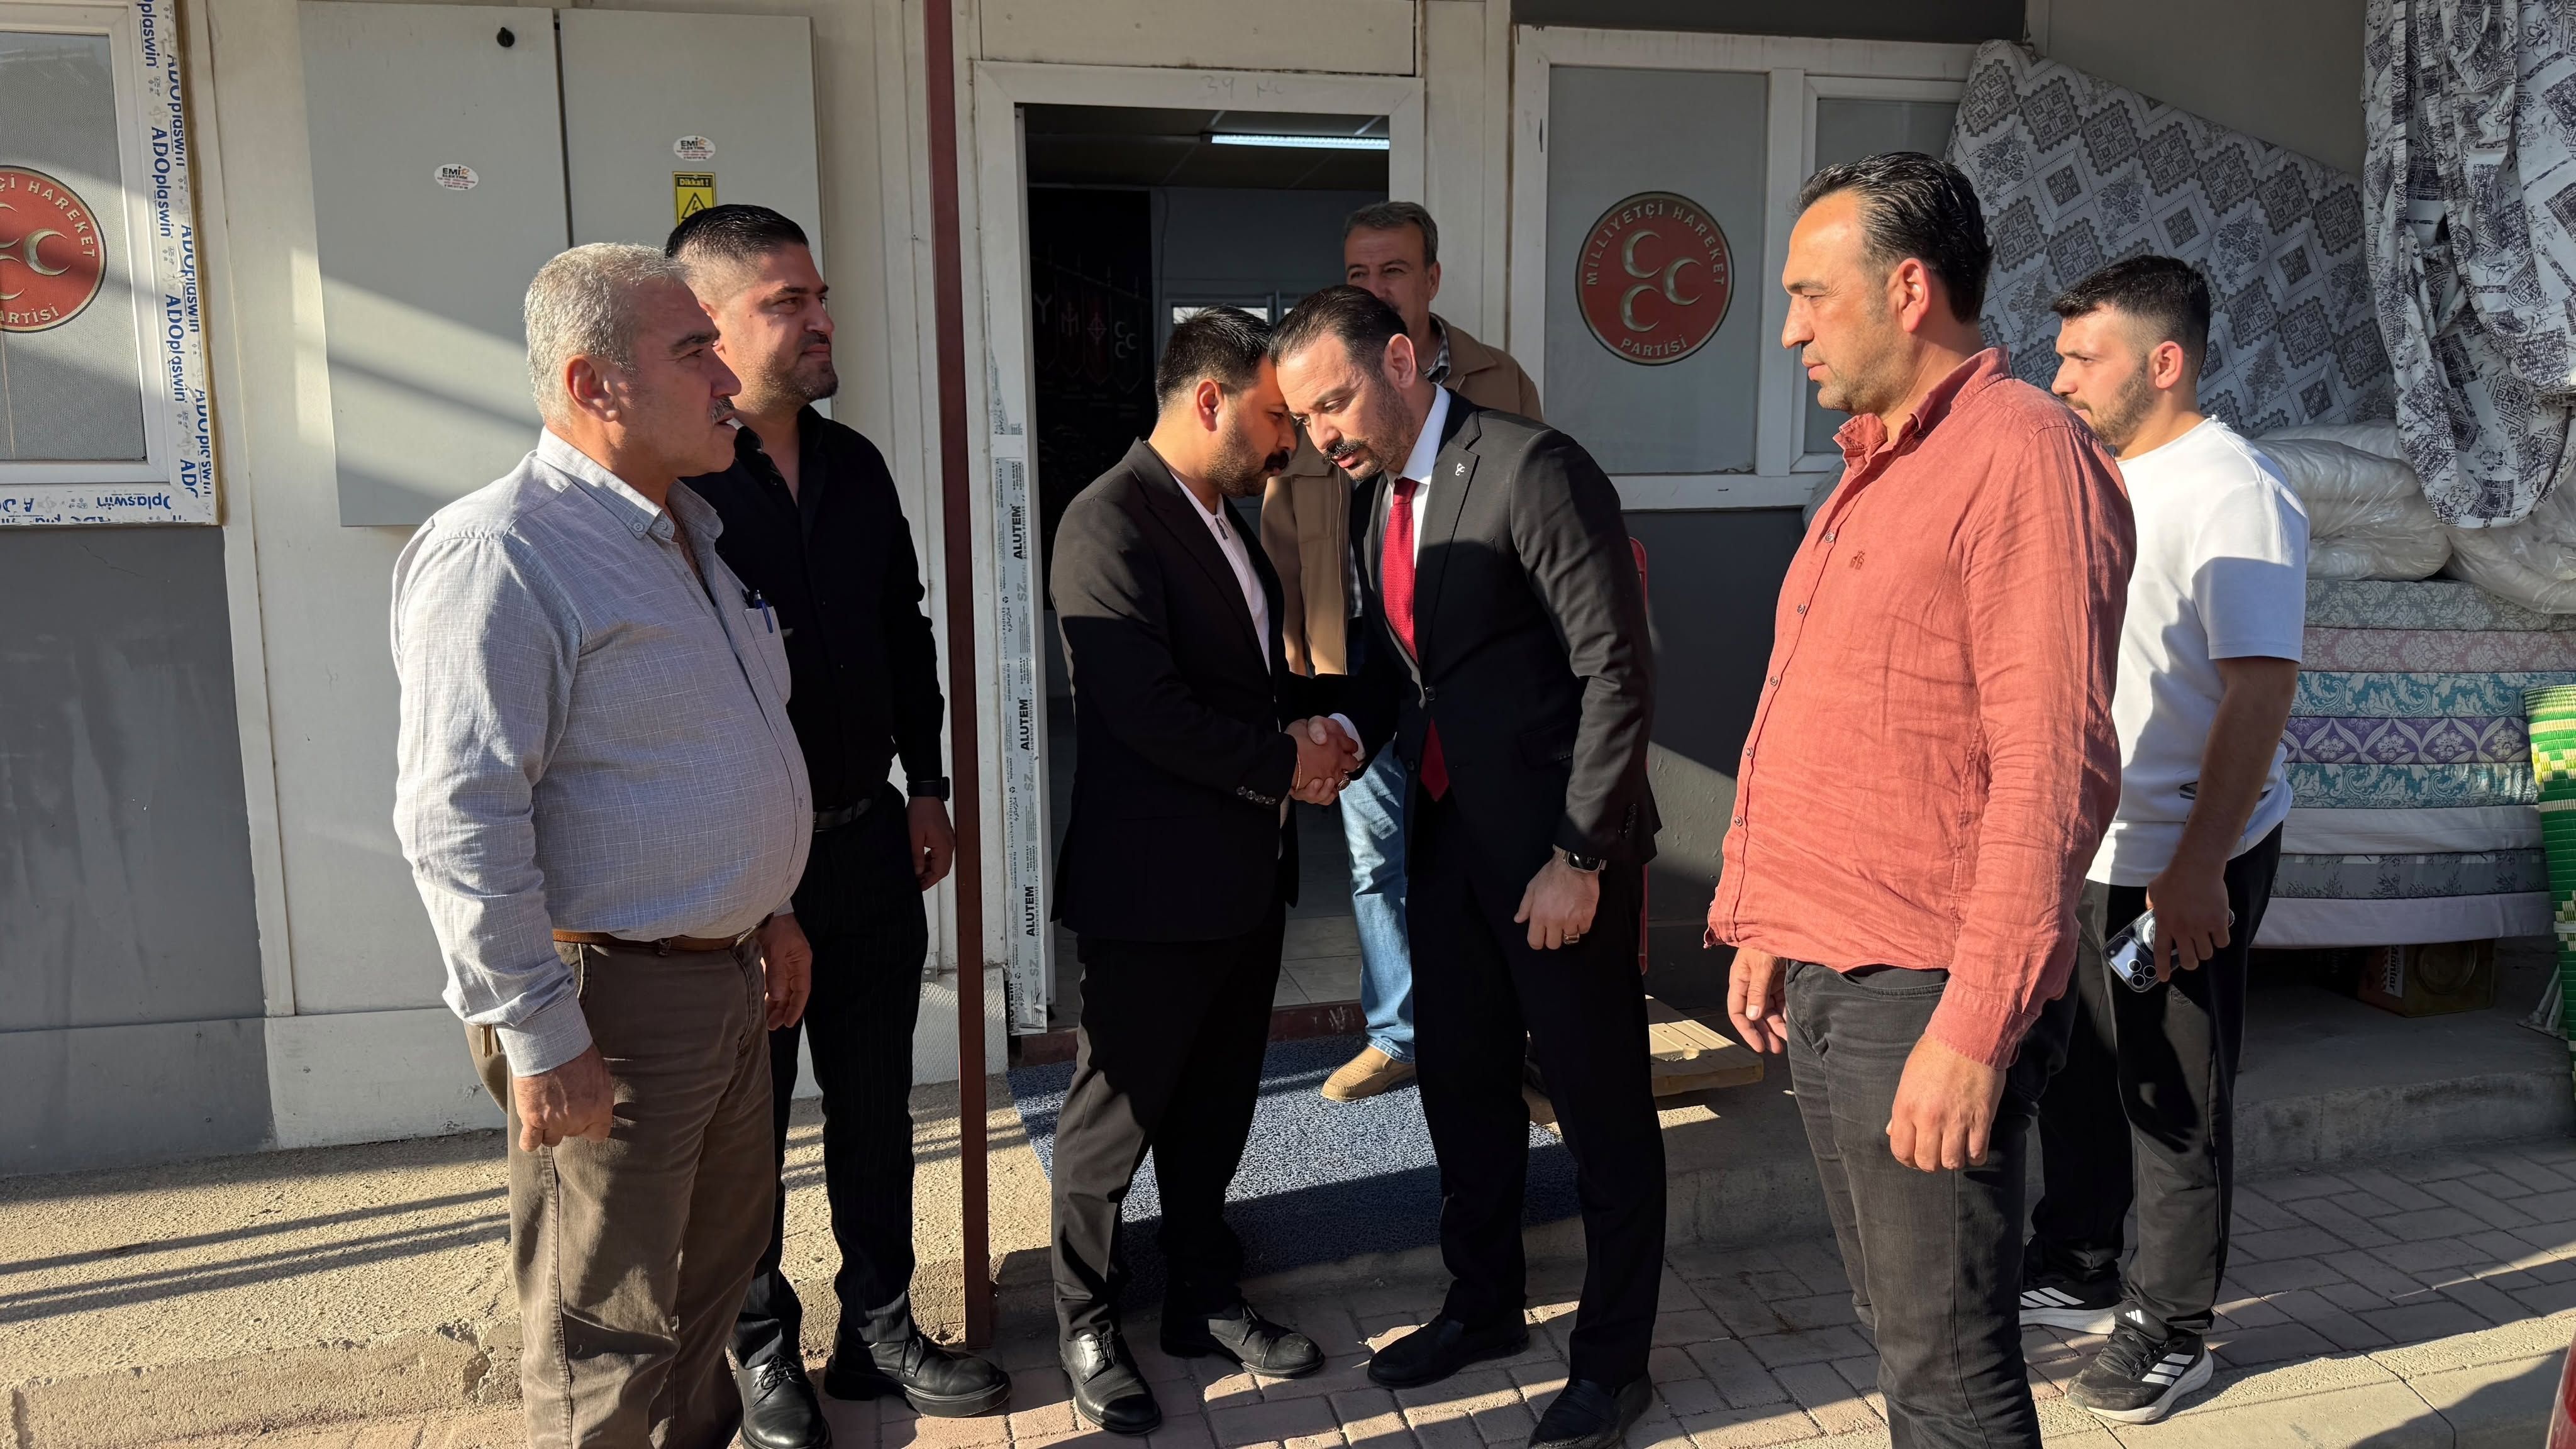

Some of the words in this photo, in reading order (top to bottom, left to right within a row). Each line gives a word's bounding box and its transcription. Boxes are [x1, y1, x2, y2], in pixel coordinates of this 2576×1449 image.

[152, 127, 174, 238] ADOplaswin
[28, 180, 95, 257] HAREKET
[1585, 199, 1664, 286] MİLLİYETÇİ
[1673, 206, 1724, 285] HAREKET
[1620, 334, 1688, 357] PARTİSİ
[1010, 506, 1023, 560] ALUTEM
[1016, 583, 1028, 602] SZ
[1019, 699, 1030, 750] ALUTEM
[1024, 774, 1035, 792] SZ
[1024, 886, 1035, 937] ALUTEM
[1029, 958, 1040, 977] SZ
